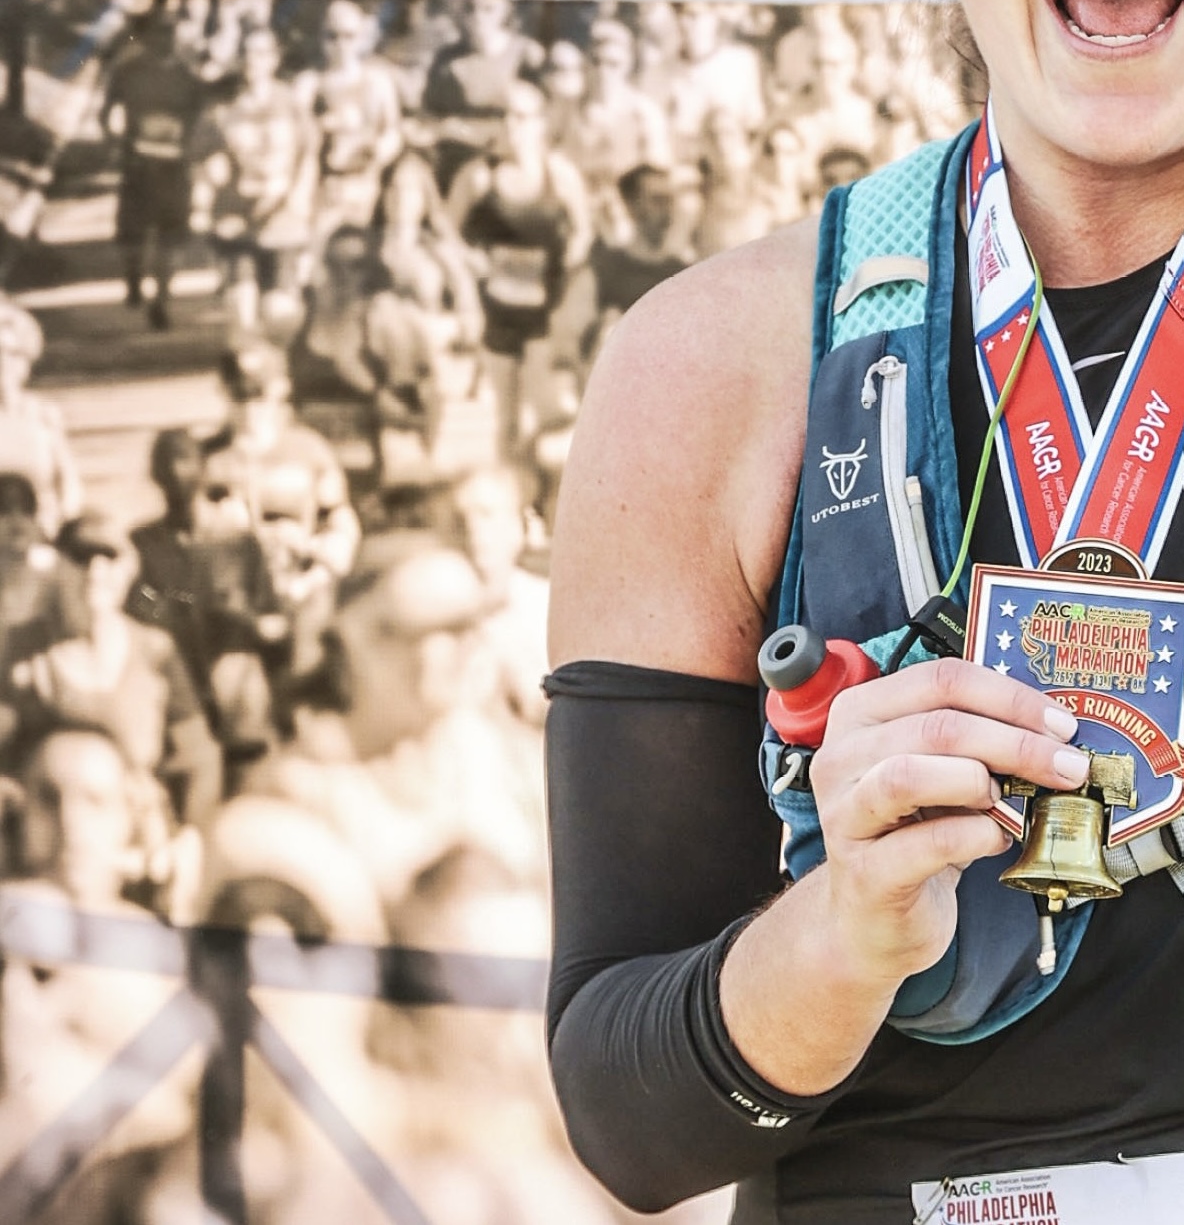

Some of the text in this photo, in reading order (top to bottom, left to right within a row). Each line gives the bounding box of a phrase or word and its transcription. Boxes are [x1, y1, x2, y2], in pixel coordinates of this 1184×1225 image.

[1127, 389, 1170, 463] AACR
[1025, 421, 1062, 480] AACR
[811, 493, 880, 523] UTOBEST
[1077, 552, 1112, 573] 2023
[1034, 602, 1085, 620] AACR
[1031, 618, 1148, 651] PHILADELPHIA
[1055, 645, 1148, 676] MARATHON
[1094, 675, 1113, 687] 13.1
[1083, 696, 1157, 747] RUNNING
[946, 1191, 1057, 1224] PHILADELPHIA
